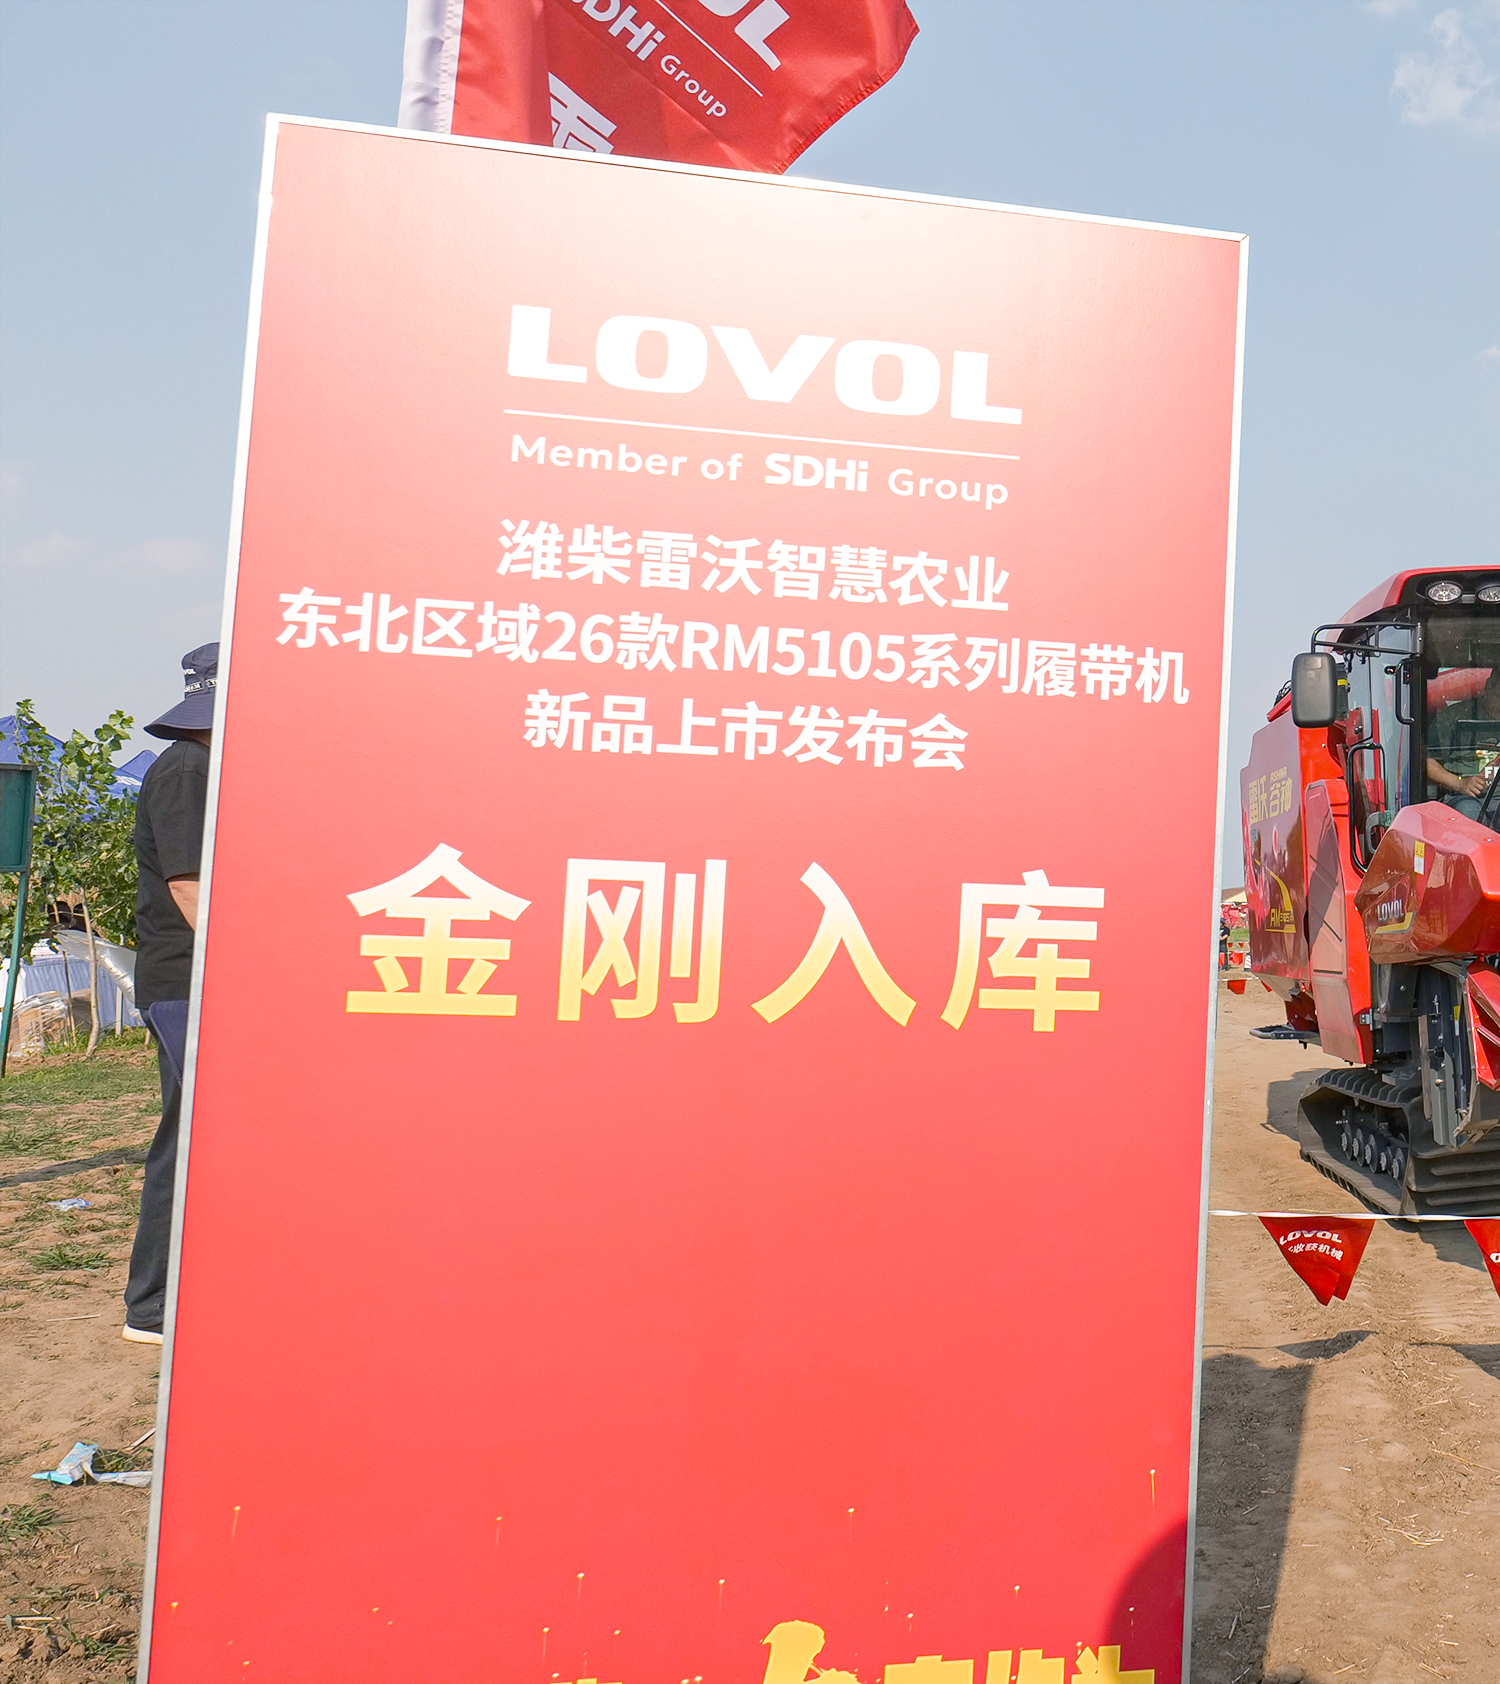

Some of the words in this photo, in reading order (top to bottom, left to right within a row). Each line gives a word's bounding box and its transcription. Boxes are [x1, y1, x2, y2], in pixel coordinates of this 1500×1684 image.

[660, 54, 727, 117] Group
[507, 303, 1022, 425] LOVOL
[511, 434, 687, 476] Member
[700, 453, 743, 481] of
[764, 453, 869, 492] SDHi
[887, 468, 1009, 511] Group
[496, 518, 1010, 612] 潍柴雷沃智慧农业
[275, 586, 1190, 705] 东北区域26款RM5105系列履带机
[522, 688, 969, 771] 新品上市发布会
[345, 842, 1106, 1033] 金刚入库
[1377, 899, 1404, 922] LOVOL
[1288, 1242, 1344, 1261] 收获机械
